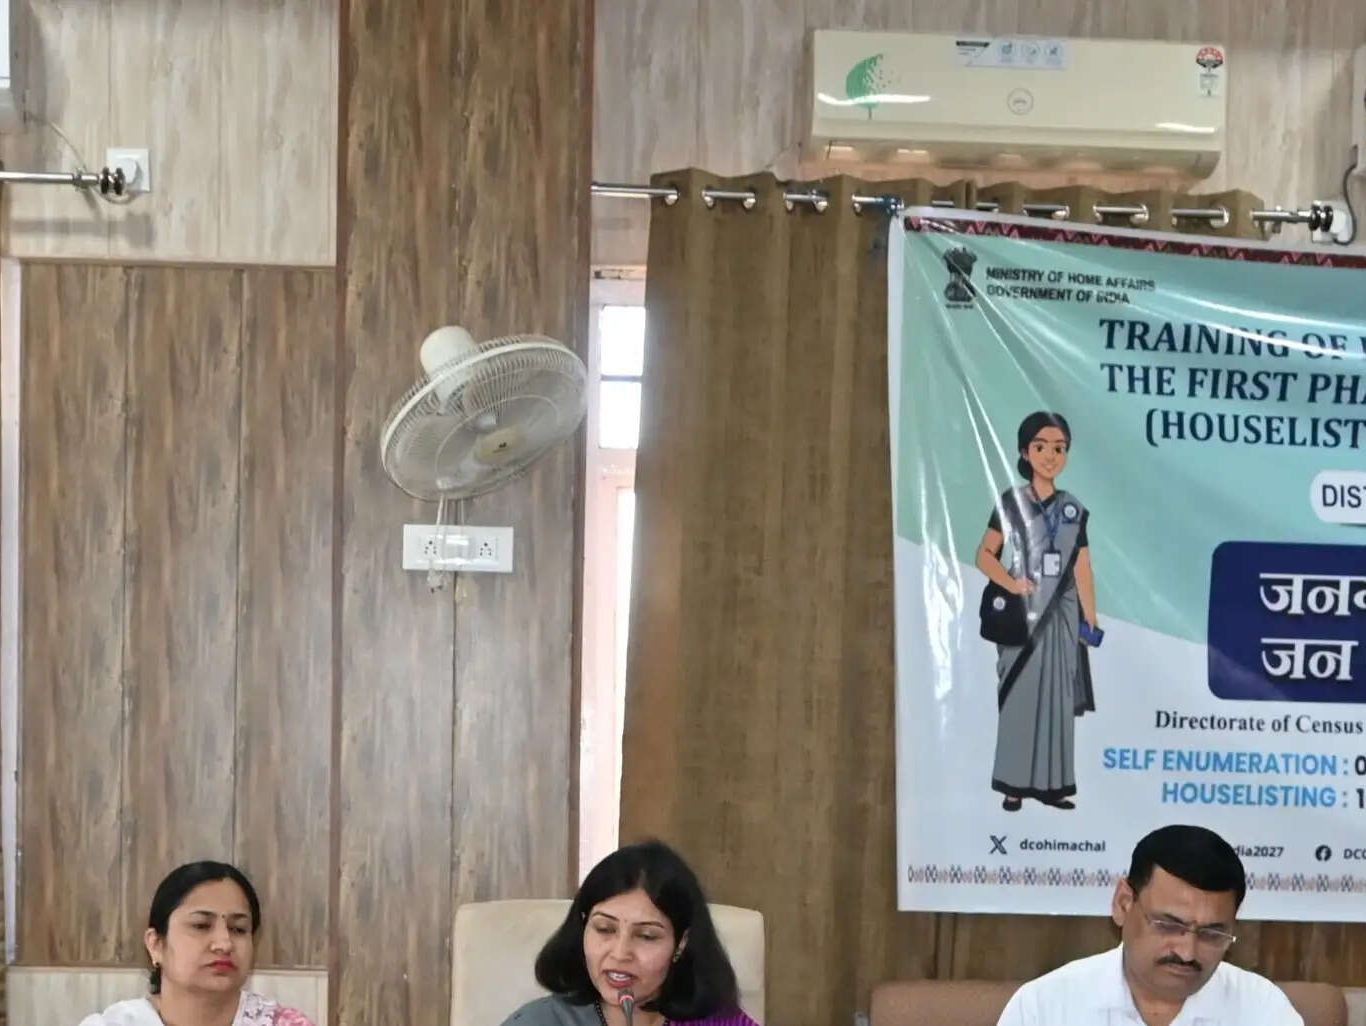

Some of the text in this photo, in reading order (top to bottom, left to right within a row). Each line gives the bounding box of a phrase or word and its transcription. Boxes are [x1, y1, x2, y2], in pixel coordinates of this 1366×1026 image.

[986, 266, 1155, 292] MINISTRY OF HOME AFFAIRS
[986, 284, 1130, 304] GOVERNMENT OF INDIA
[1099, 318, 1290, 358] TRAINING
[1301, 333, 1348, 360] OF
[1099, 363, 1176, 397] THE
[1186, 367, 1299, 403] FIRST
[1261, 637, 1360, 681] जन
[1154, 710, 1265, 732] Directorate
[1271, 715, 1292, 732] of
[1295, 714, 1364, 735] Census
[1103, 747, 1157, 770] SELF
[1162, 749, 1338, 776] ENUMERATION
[1161, 781, 1337, 808] HOUSELISTING
[1019, 838, 1107, 852] dcohimachal
